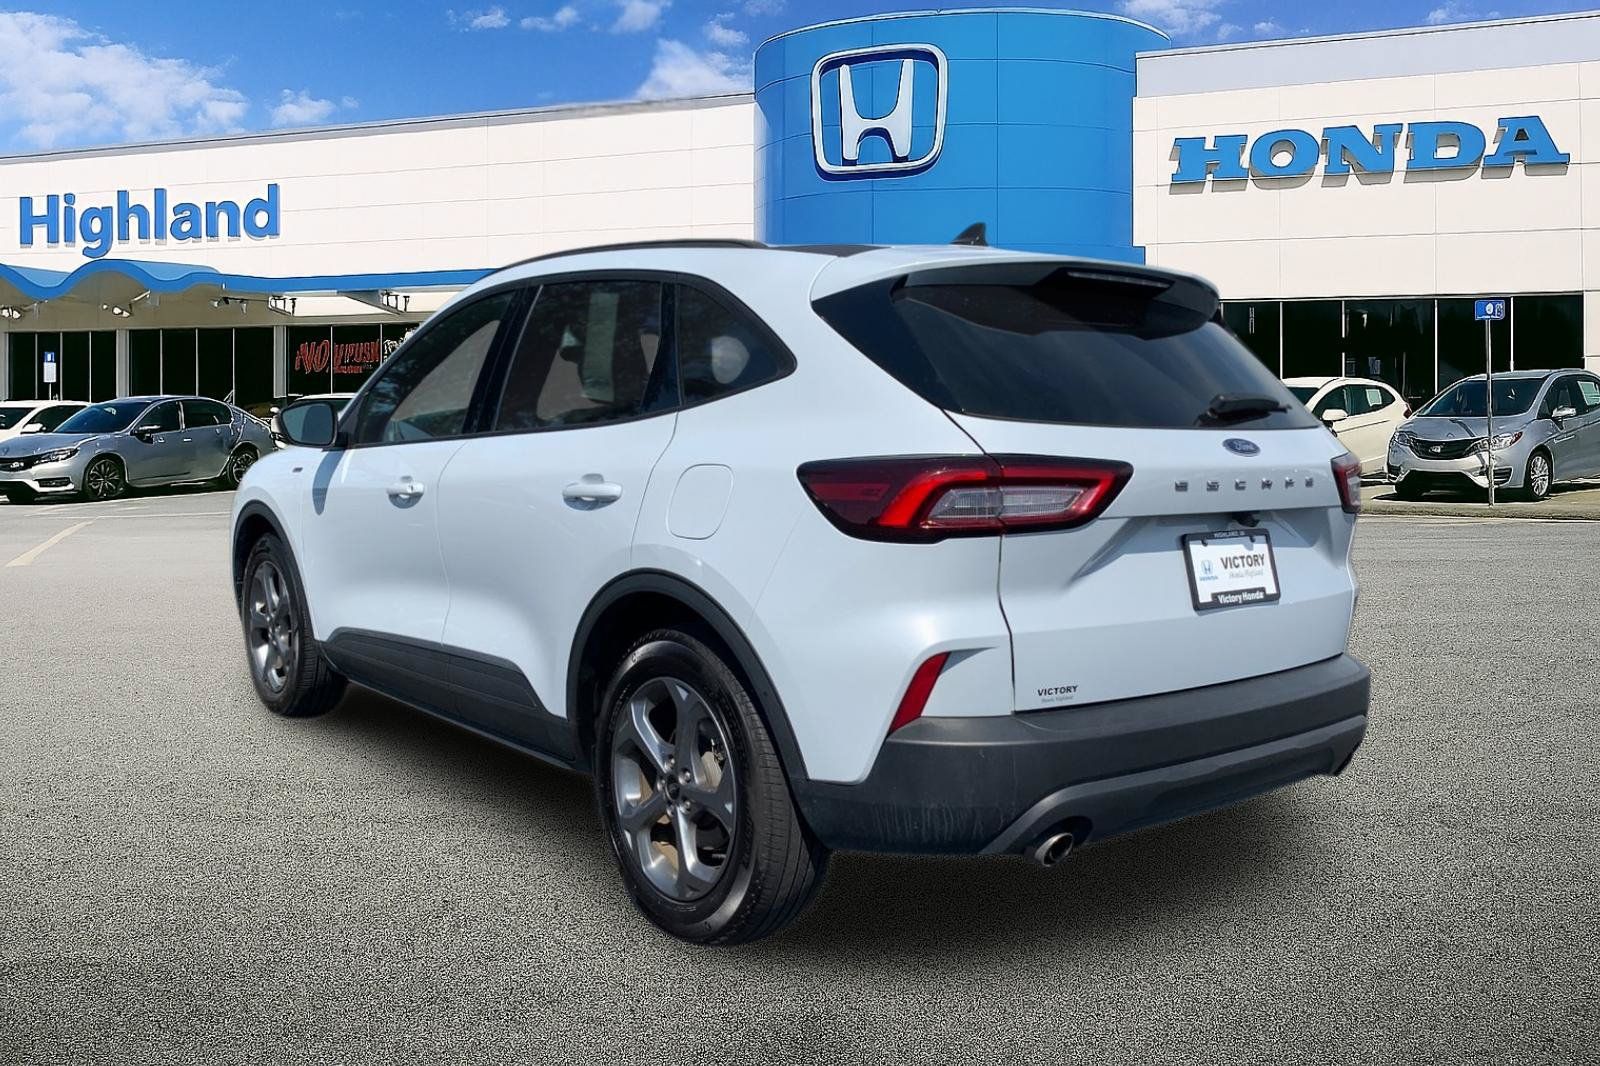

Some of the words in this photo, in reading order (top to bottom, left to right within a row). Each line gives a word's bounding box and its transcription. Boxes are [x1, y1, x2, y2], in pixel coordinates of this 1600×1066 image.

[1171, 115, 1571, 183] HONDA
[19, 183, 281, 259] Highland
[1220, 553, 1264, 569] VICTORY
[1217, 594, 1242, 604] Victory
[1242, 590, 1264, 601] Honda
[1037, 685, 1079, 697] VICTORY
